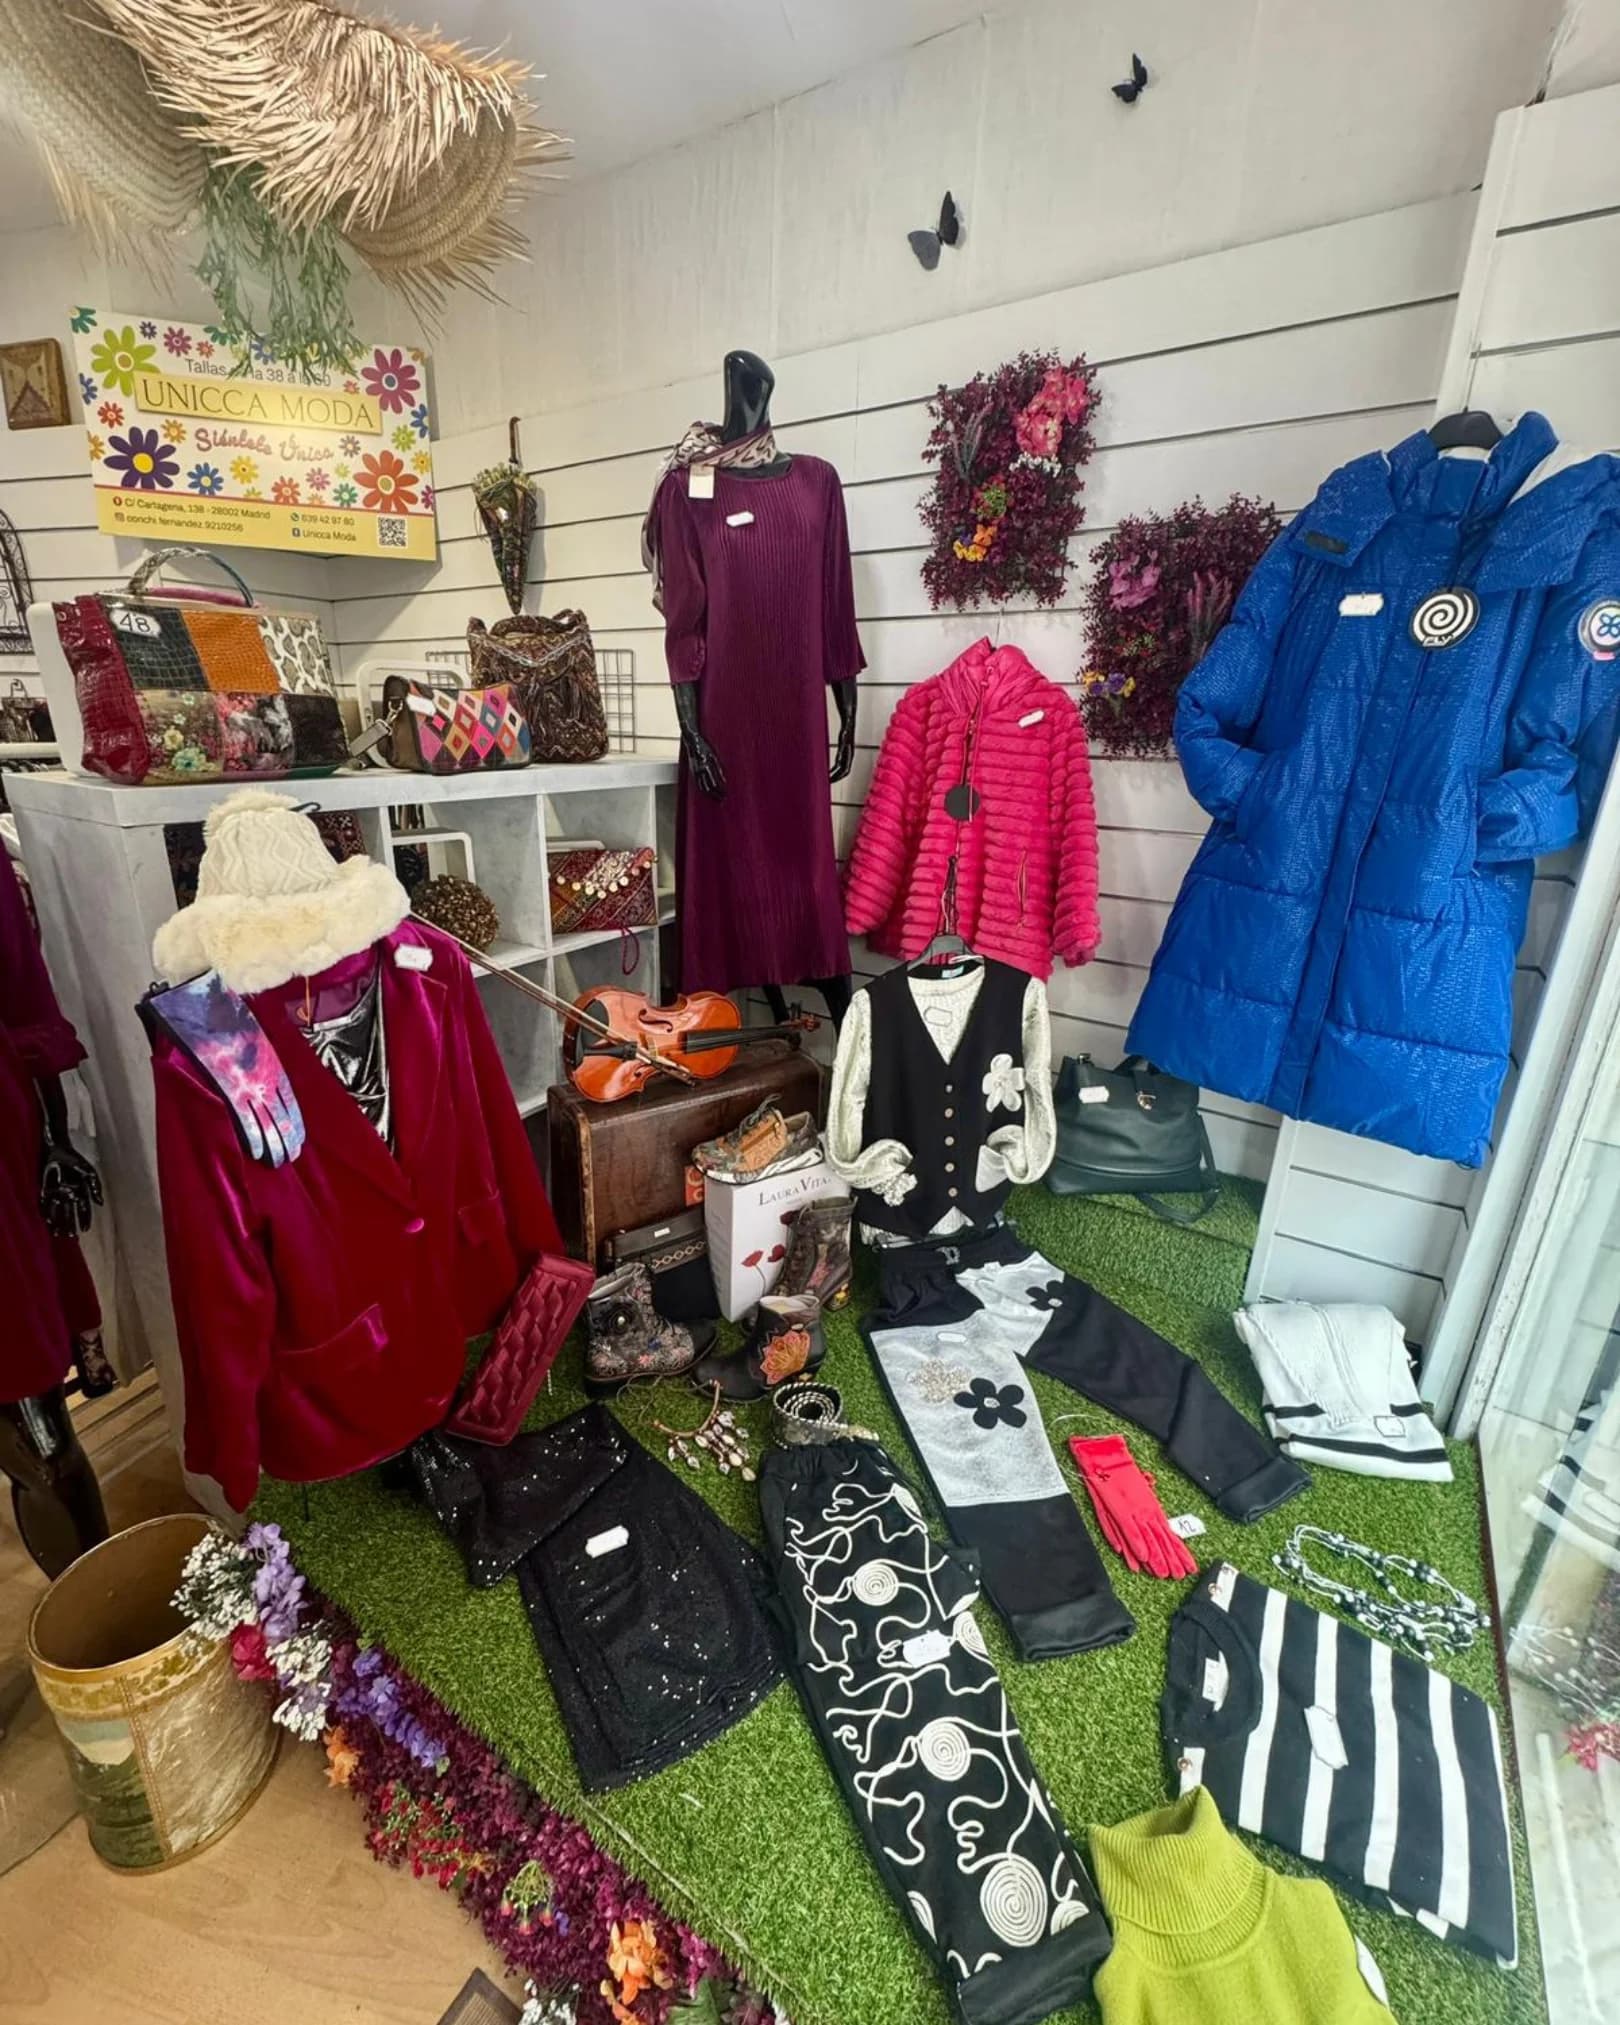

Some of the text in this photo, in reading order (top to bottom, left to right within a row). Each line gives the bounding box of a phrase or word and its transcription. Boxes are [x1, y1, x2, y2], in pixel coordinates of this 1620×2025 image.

[185, 358, 227, 376] Tallas
[266, 368, 284, 383] 38
[142, 378, 374, 429] UNICCA MODA
[240, 508, 271, 520] Madrid
[332, 530, 357, 542] Moda
[119, 612, 151, 633] 48
[758, 1187, 800, 1206] LAURA
[1177, 1518, 1197, 1535] 12
